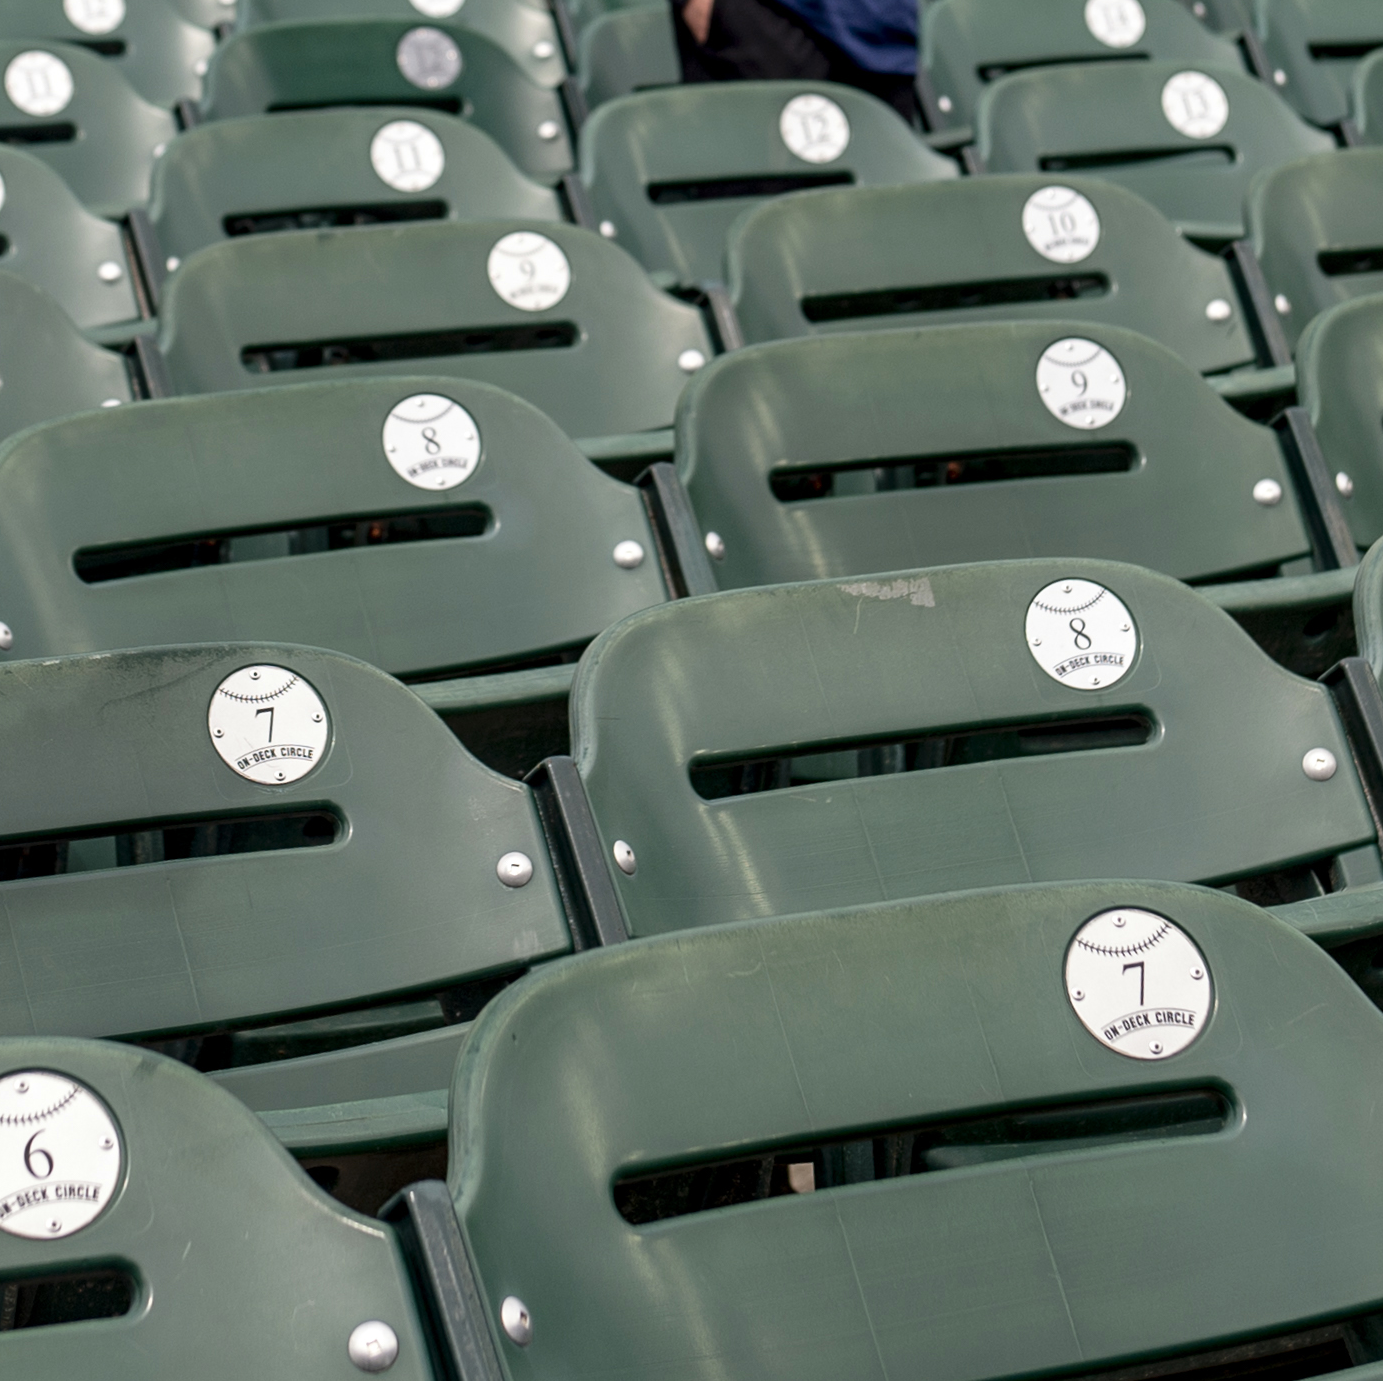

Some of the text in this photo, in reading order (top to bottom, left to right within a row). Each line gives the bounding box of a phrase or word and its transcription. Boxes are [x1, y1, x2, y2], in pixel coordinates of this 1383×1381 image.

[798, 113, 831, 145] 12
[391, 143, 423, 175] 11
[1045, 211, 1074, 237] 10
[519, 259, 537, 284] 9
[1070, 369, 1088, 397] 9
[421, 426, 442, 455] 8
[1068, 617, 1093, 651] 8
[1055, 653, 1124, 677] ON-DECK CIRCLE
[254, 706, 275, 743] 7
[237, 747, 314, 770] ON-DECK CIRCLE
[1121, 960, 1145, 1007] 7
[1103, 1010, 1195, 1041] ON-DECK CIRCLE
[23, 1127, 55, 1179] 6
[54, 1183, 101, 1200] CIRCLE
